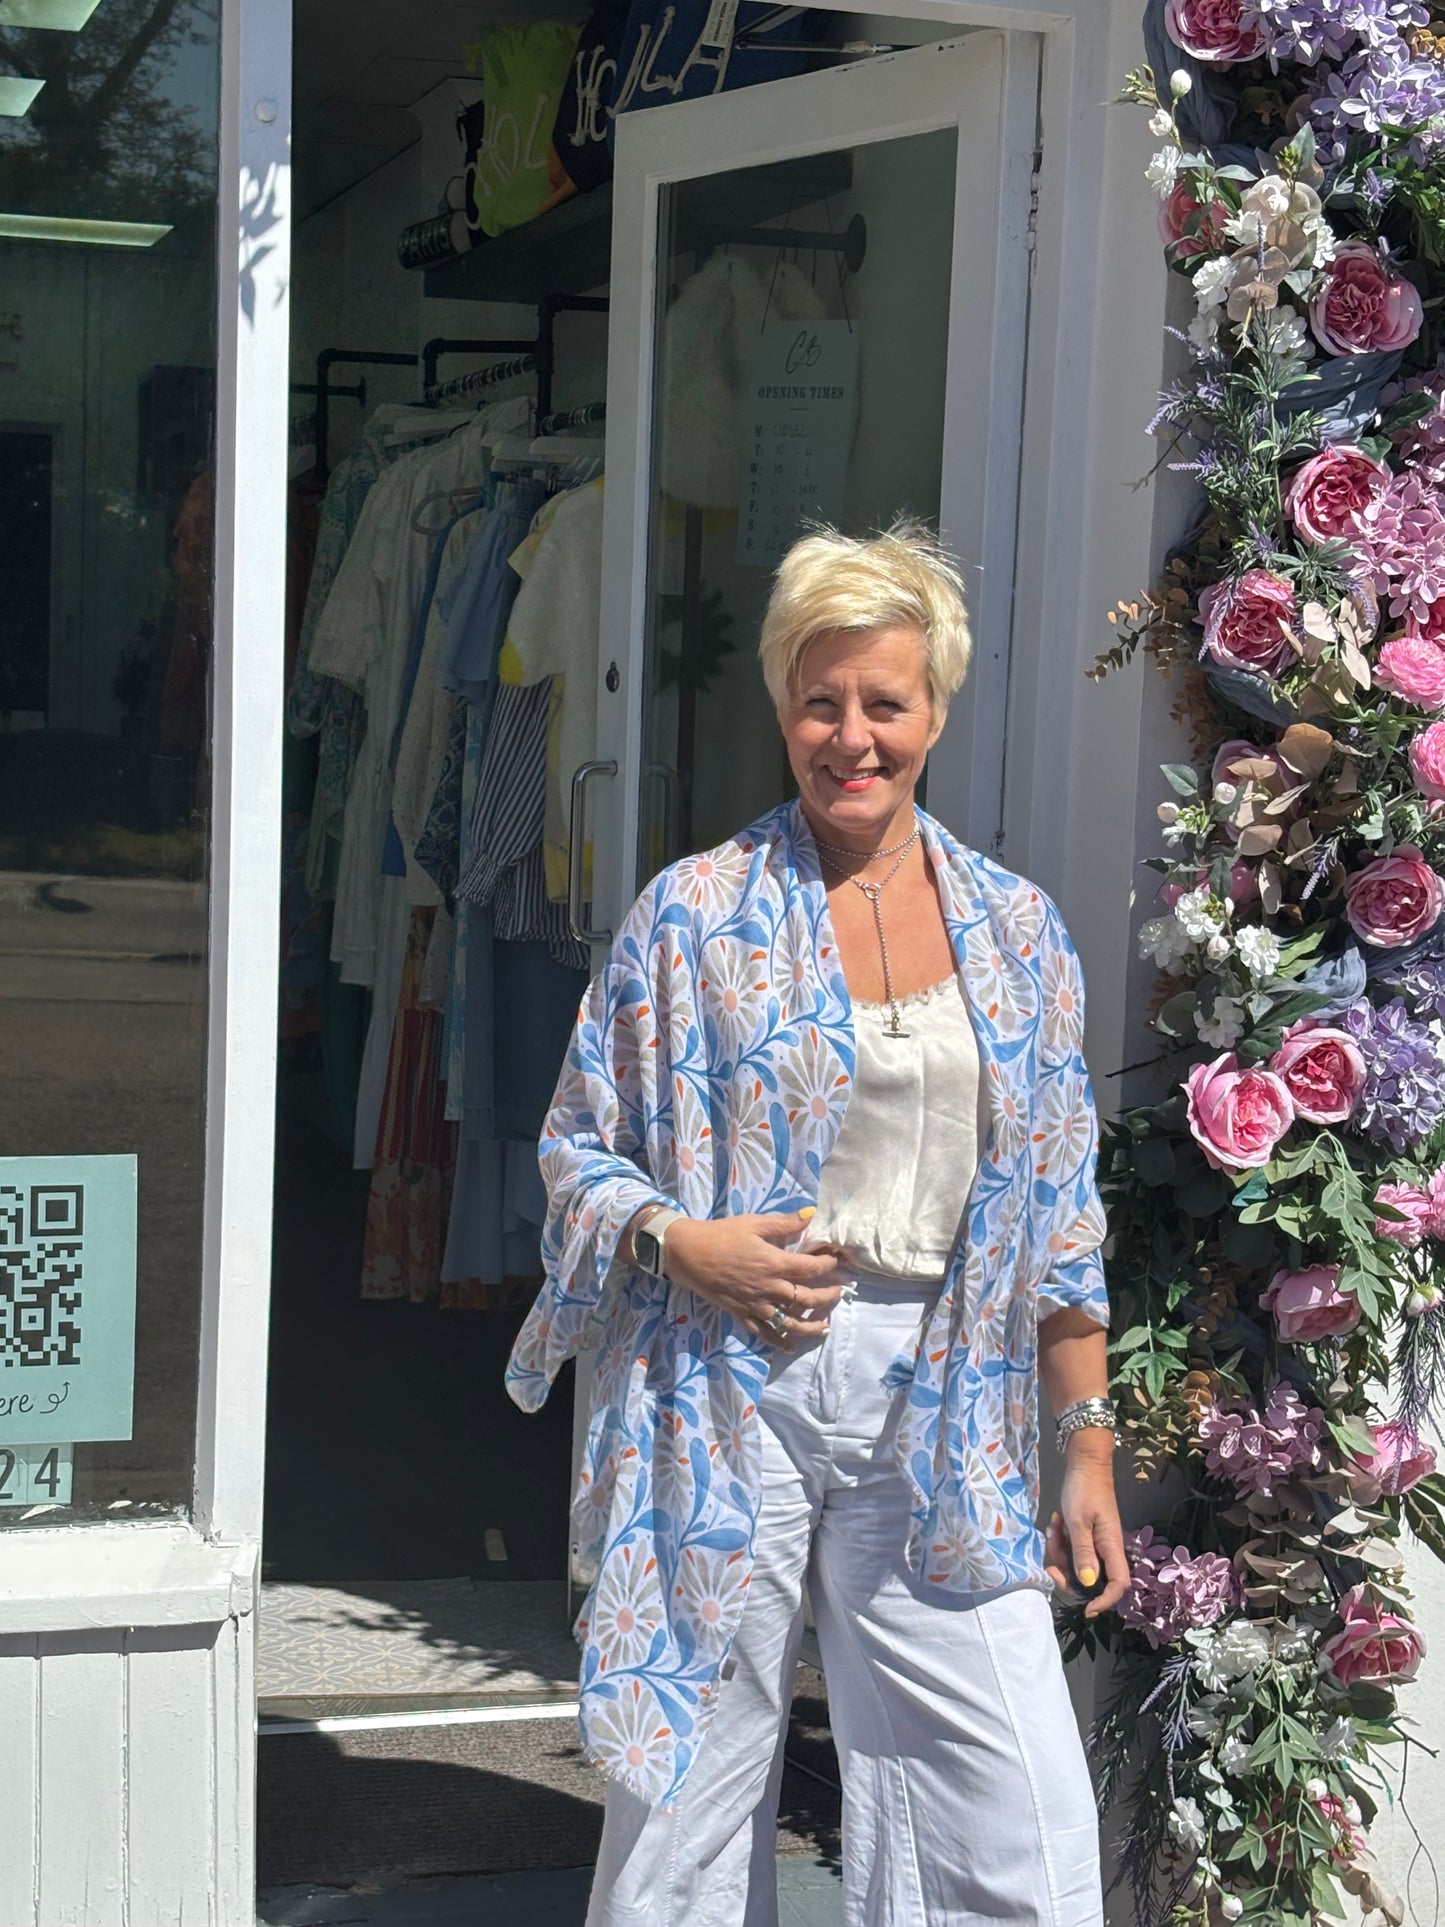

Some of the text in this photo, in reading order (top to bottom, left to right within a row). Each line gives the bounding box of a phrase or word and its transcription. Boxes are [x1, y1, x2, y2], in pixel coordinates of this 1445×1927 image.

[758, 386, 845, 399] OPENING TIMES
[0, 1394, 33, 1416] ere
